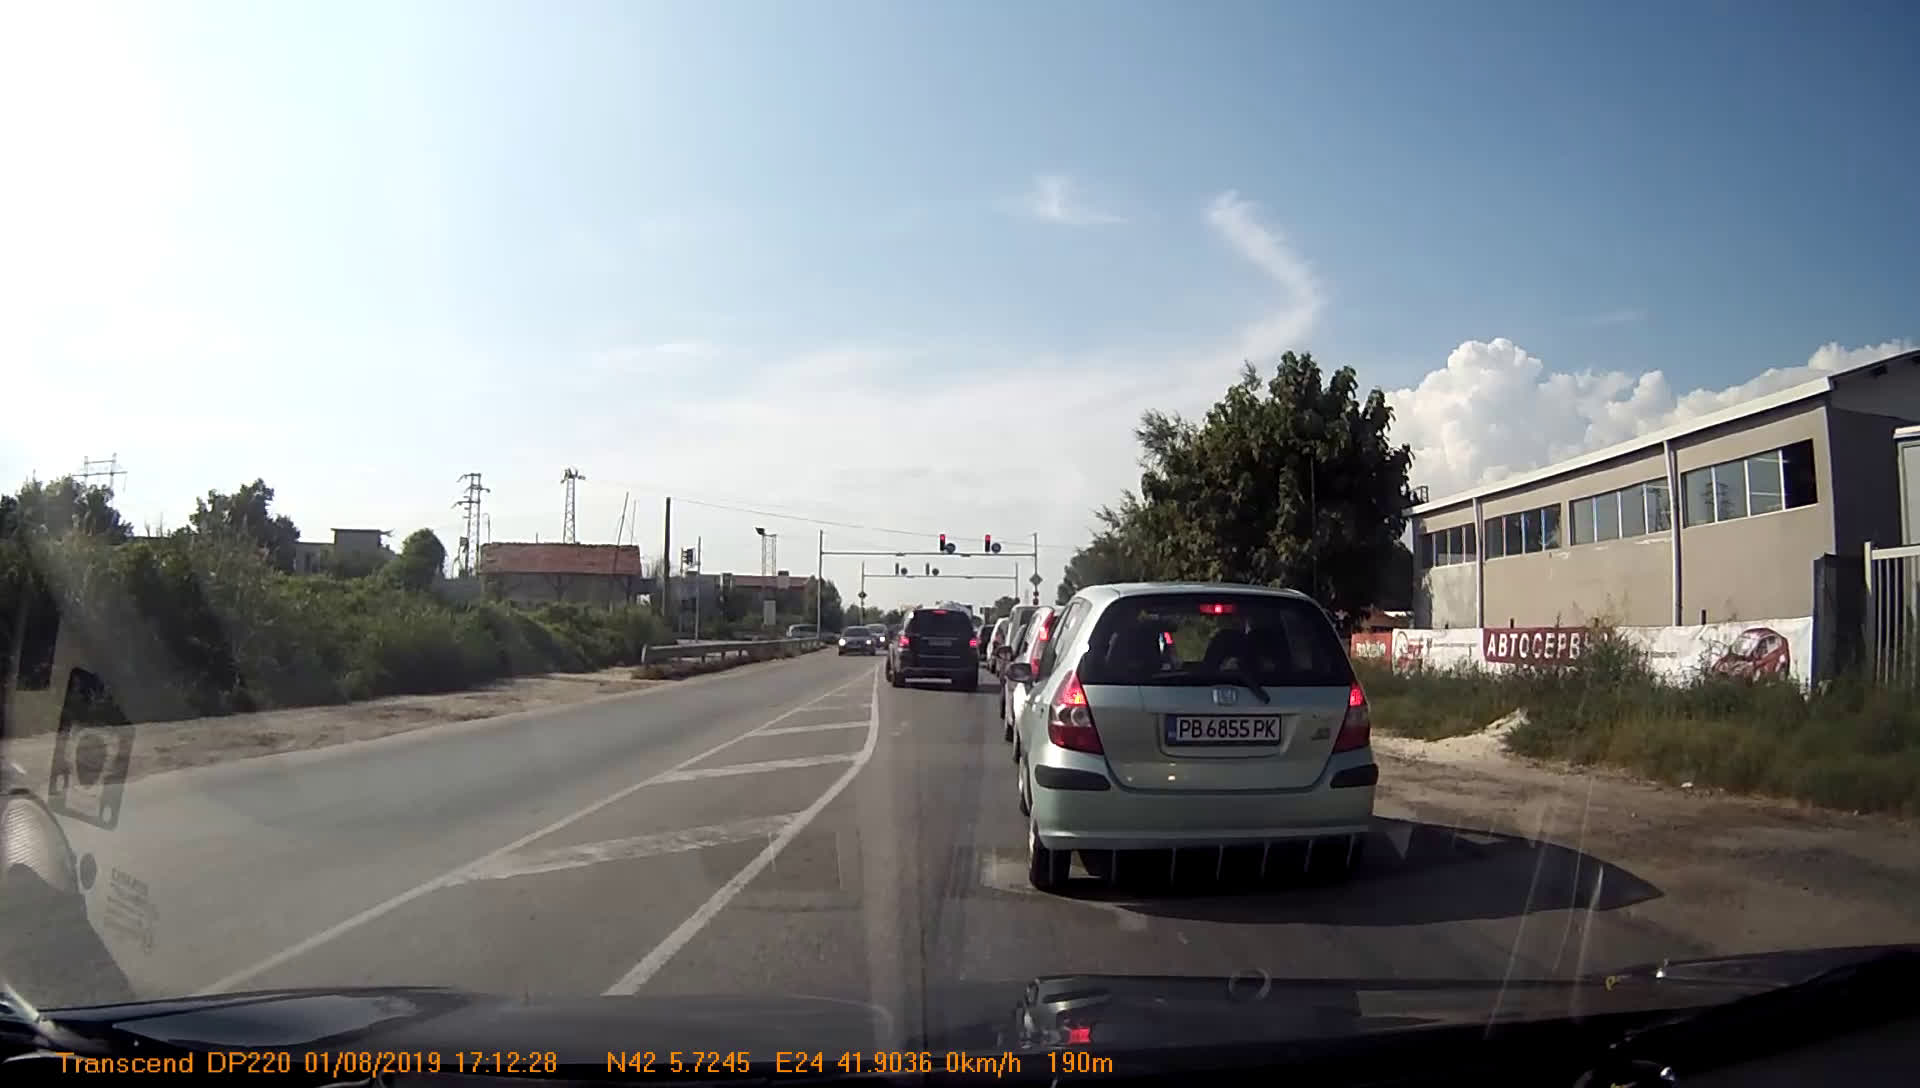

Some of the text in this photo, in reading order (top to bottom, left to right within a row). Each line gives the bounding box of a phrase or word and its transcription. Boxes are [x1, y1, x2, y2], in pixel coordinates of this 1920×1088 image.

[1487, 632, 1608, 659] АВТОСЕРВ
[1179, 719, 1276, 738] PB 6855 PK
